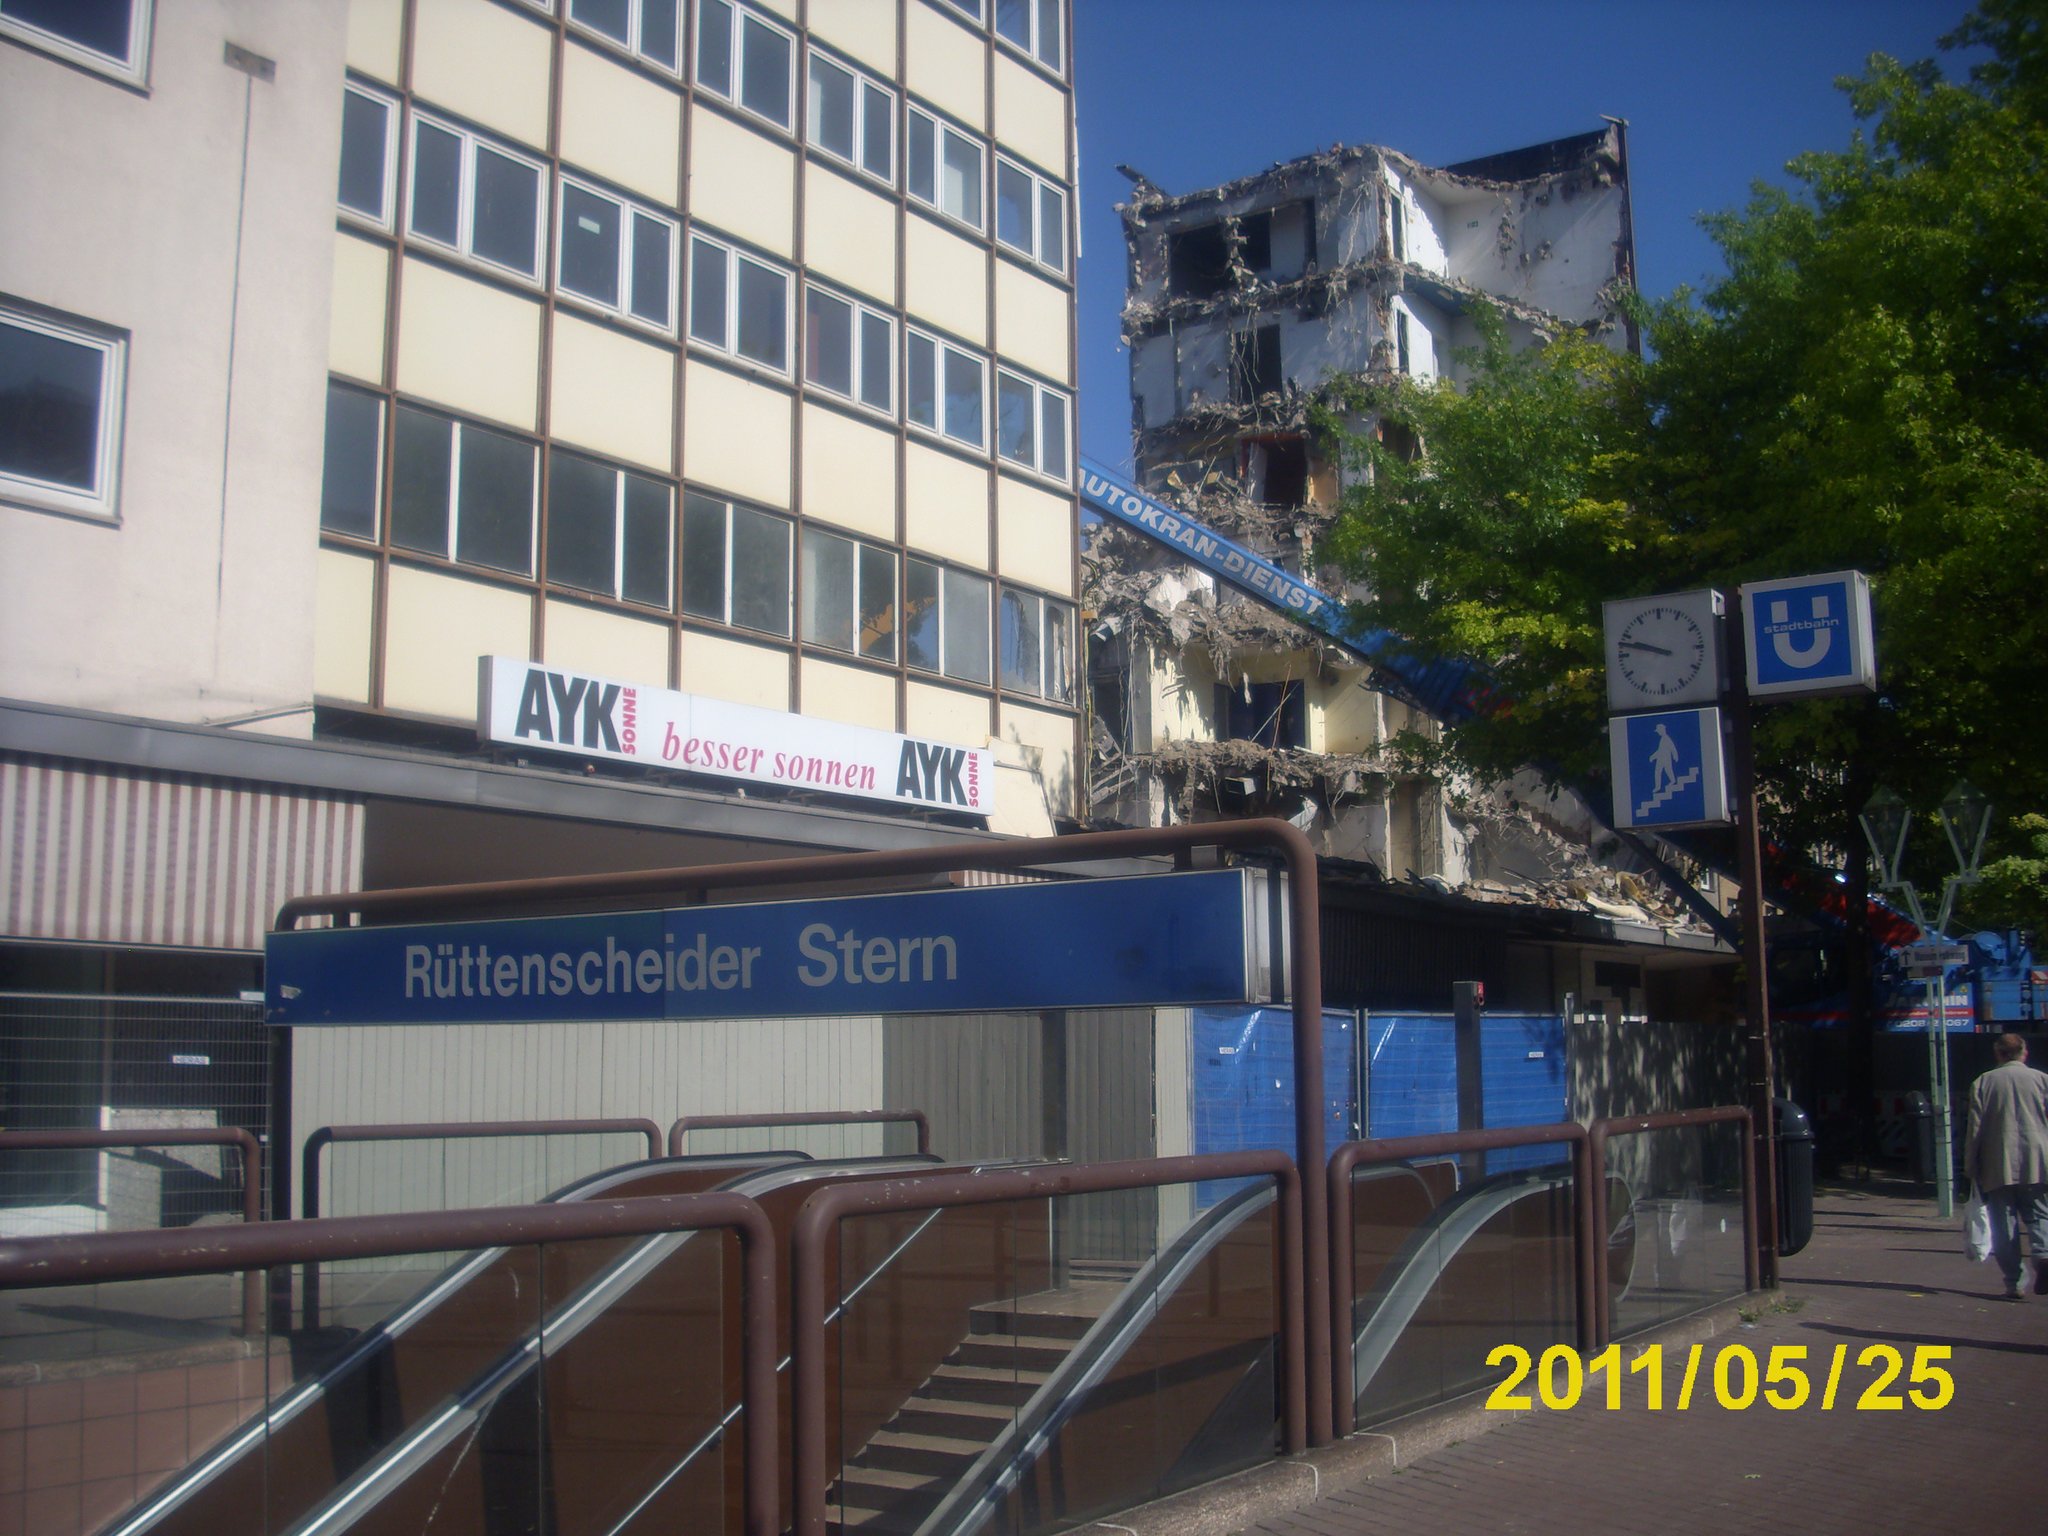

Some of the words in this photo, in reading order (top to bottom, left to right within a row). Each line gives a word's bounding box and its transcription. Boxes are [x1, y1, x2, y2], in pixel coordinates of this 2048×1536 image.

[1764, 619, 1839, 634] stadtbahn
[514, 668, 622, 753] AYK
[622, 688, 636, 755] SONNE
[662, 721, 764, 774] besser
[773, 752, 876, 790] sonnen
[896, 739, 968, 806] AYK
[969, 752, 979, 808] SONNE
[405, 933, 761, 999] Rüttenscheider
[797, 922, 957, 988] Stern
